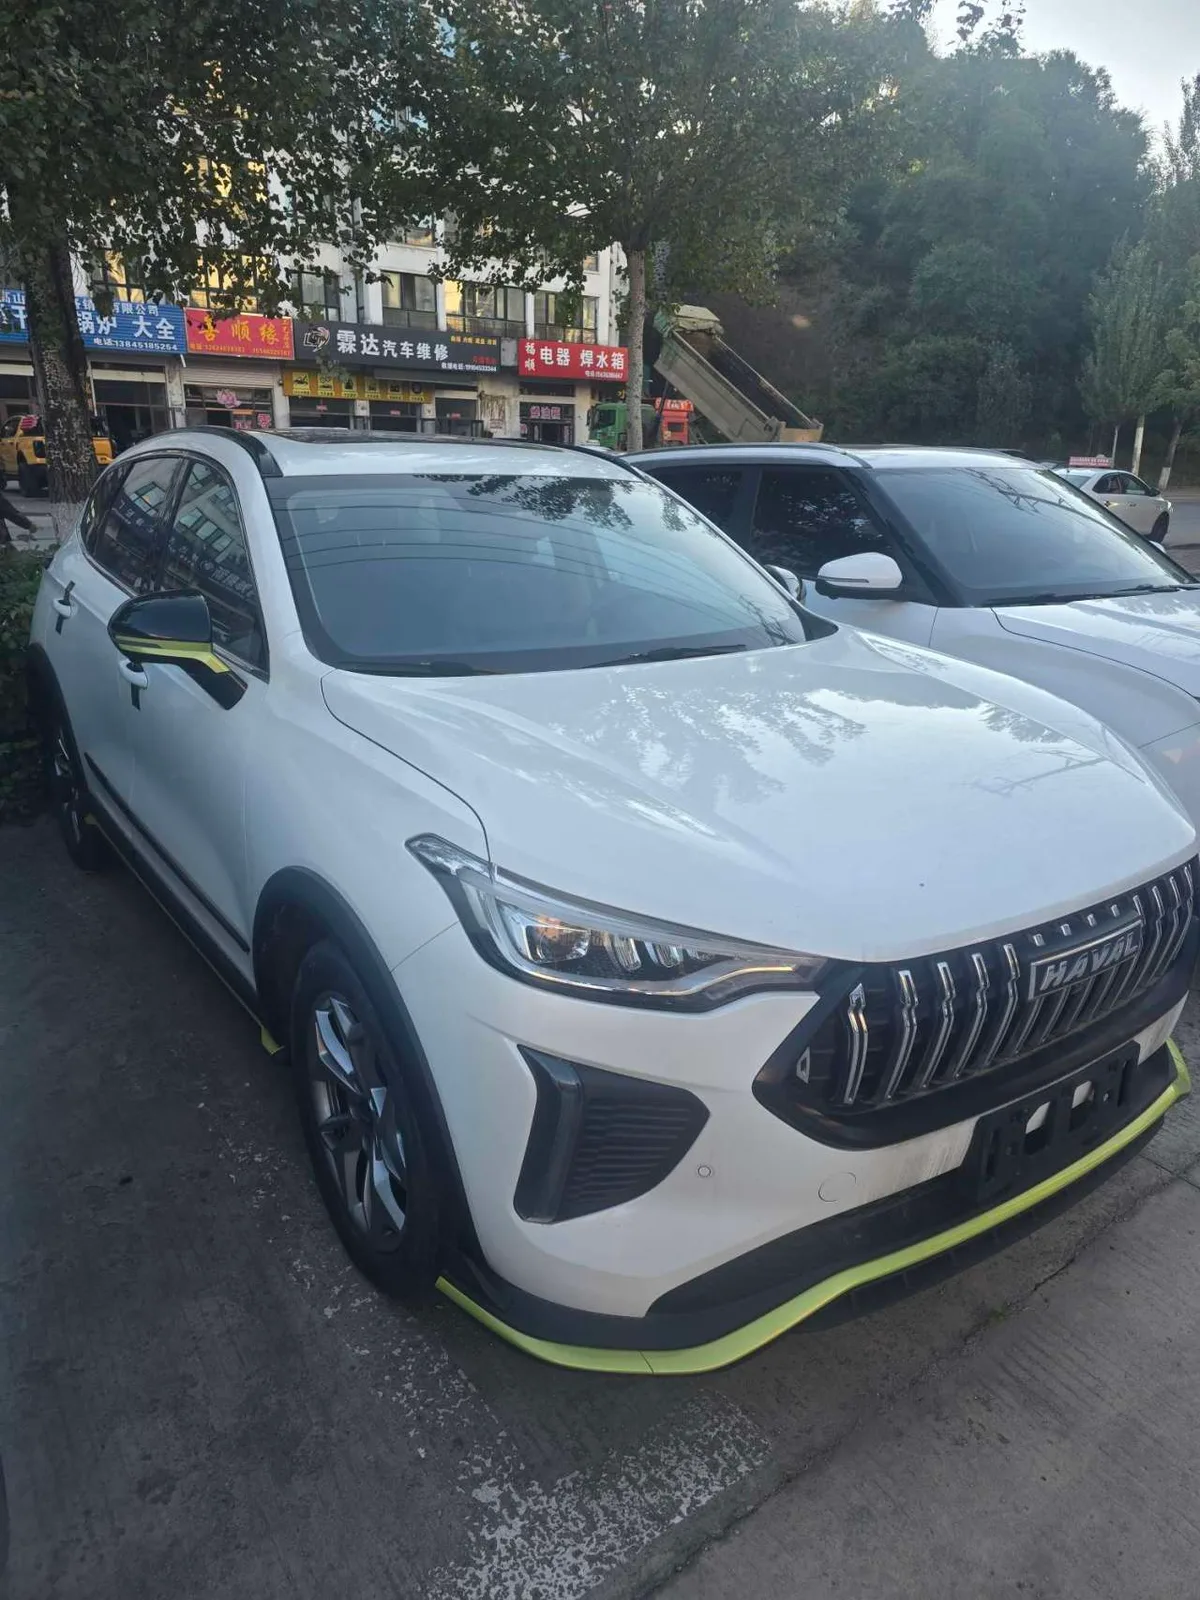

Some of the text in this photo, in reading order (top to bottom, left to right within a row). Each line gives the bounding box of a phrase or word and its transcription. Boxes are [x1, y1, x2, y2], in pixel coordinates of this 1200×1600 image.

[77, 311, 117, 335] 锅炉
[132, 315, 175, 340] 大全
[540, 346, 625, 370] 电器 焊水箱
[1040, 932, 1139, 991] HAVAL
